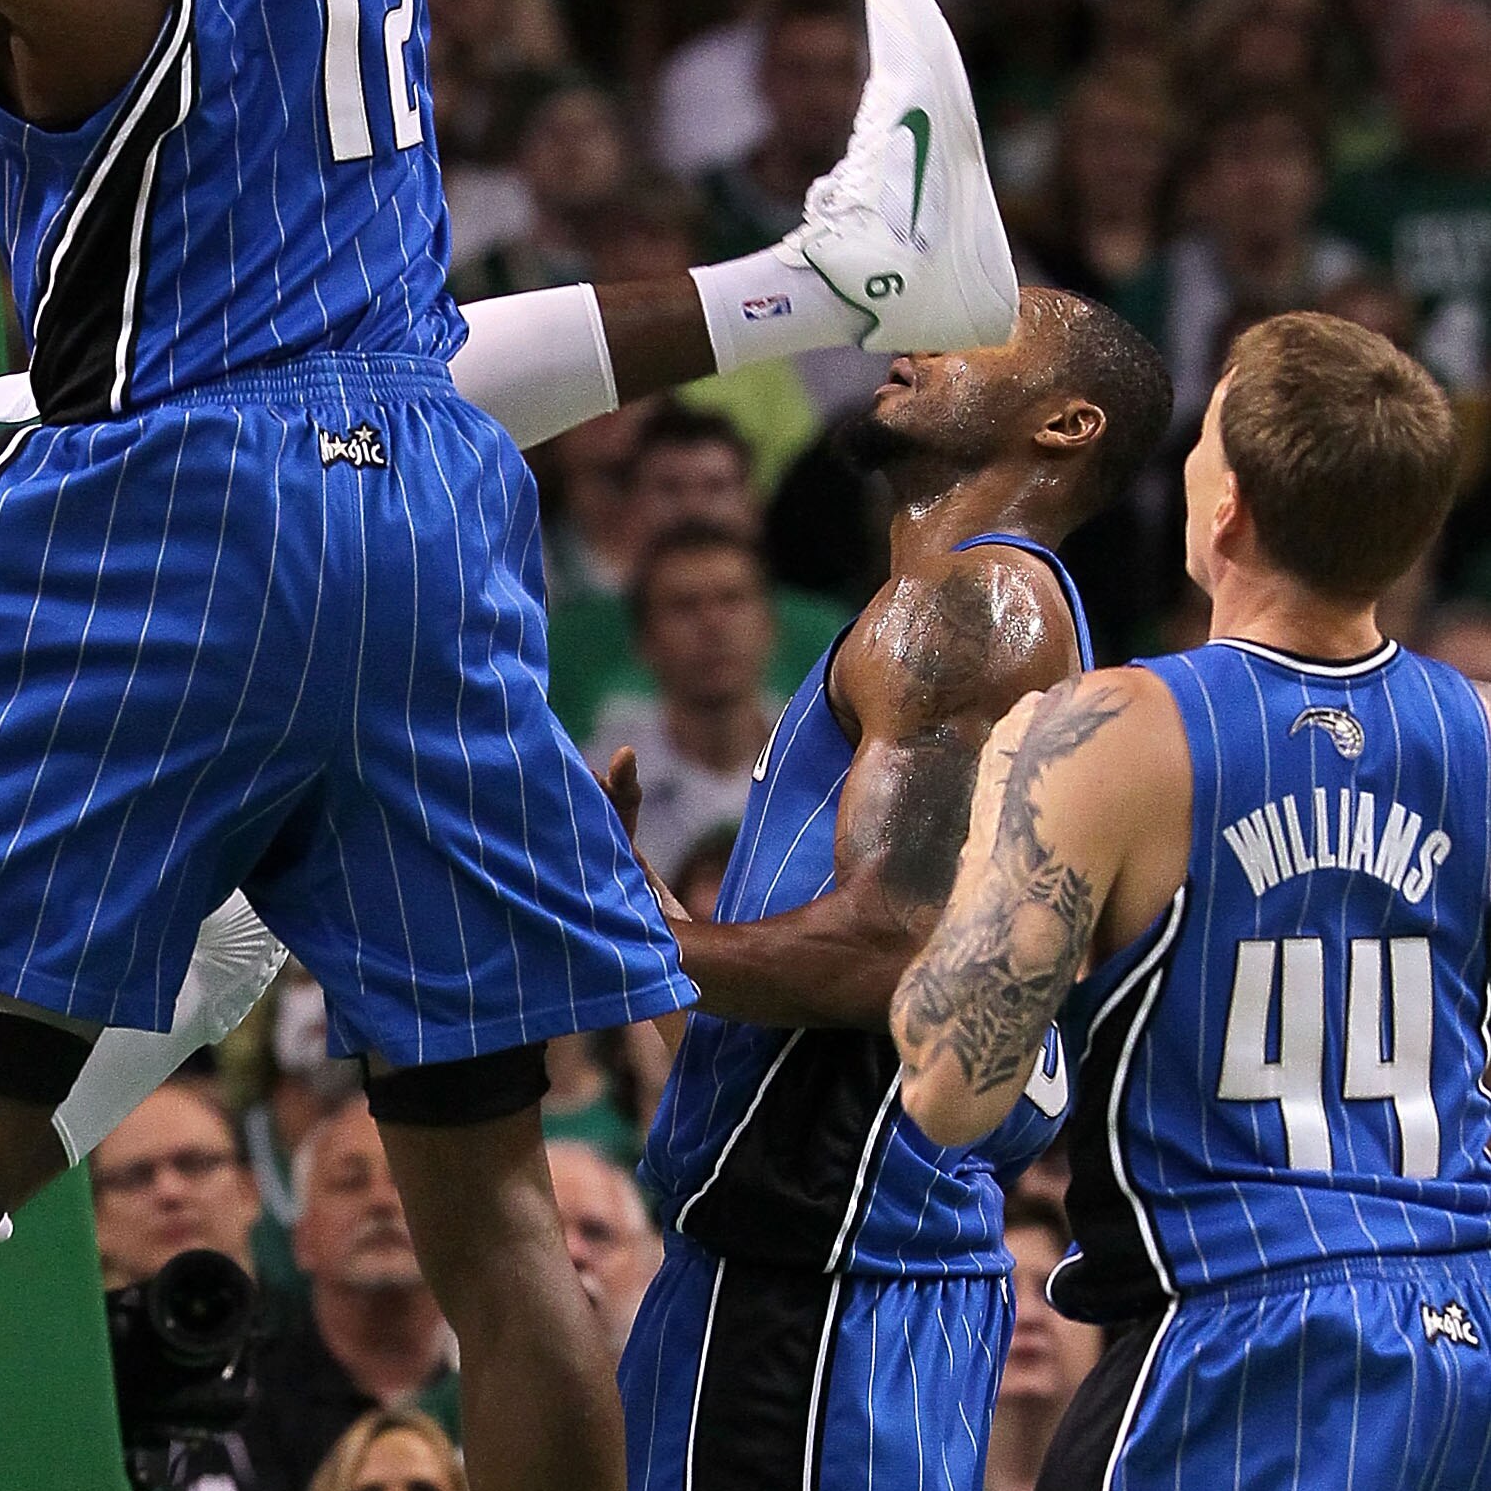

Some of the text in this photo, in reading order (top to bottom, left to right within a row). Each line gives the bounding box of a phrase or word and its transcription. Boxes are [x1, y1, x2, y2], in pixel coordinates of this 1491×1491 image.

[863, 273, 905, 301] 6
[1223, 786, 1451, 905] WILLIAMS
[1217, 937, 1441, 1178] 44
